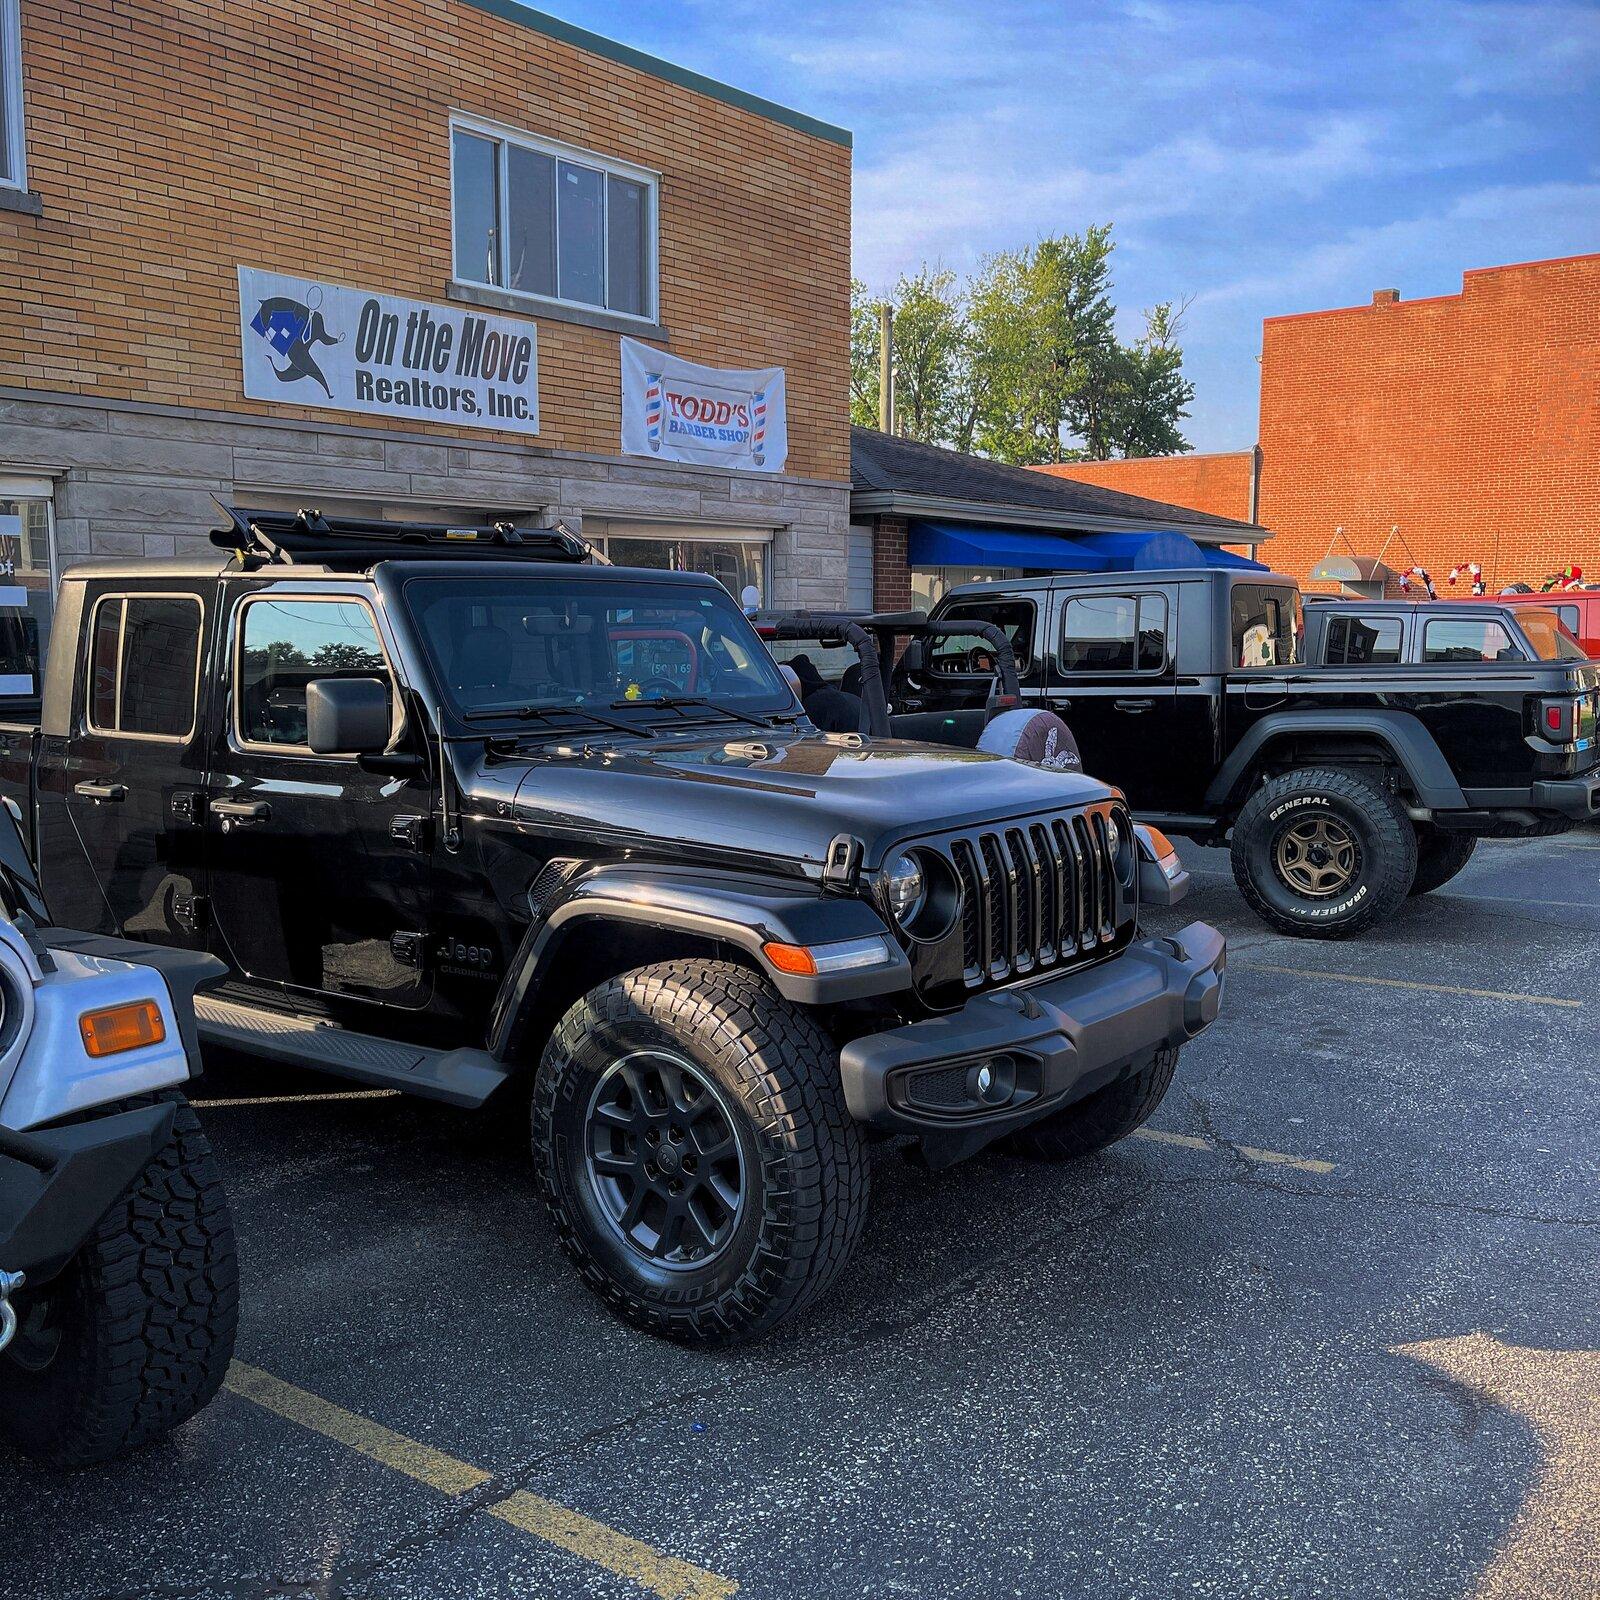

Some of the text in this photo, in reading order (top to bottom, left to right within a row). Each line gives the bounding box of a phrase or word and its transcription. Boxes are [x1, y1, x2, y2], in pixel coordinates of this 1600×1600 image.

[355, 299, 531, 385] On the Move
[355, 369, 535, 421] Realtors, Inc.
[666, 392, 749, 428] TODD'S
[669, 420, 750, 443] BARBER SHOP
[1269, 797, 1330, 821] GENERAL
[1290, 885, 1367, 916] GRABBER A/T
[437, 936, 492, 967] Jeep
